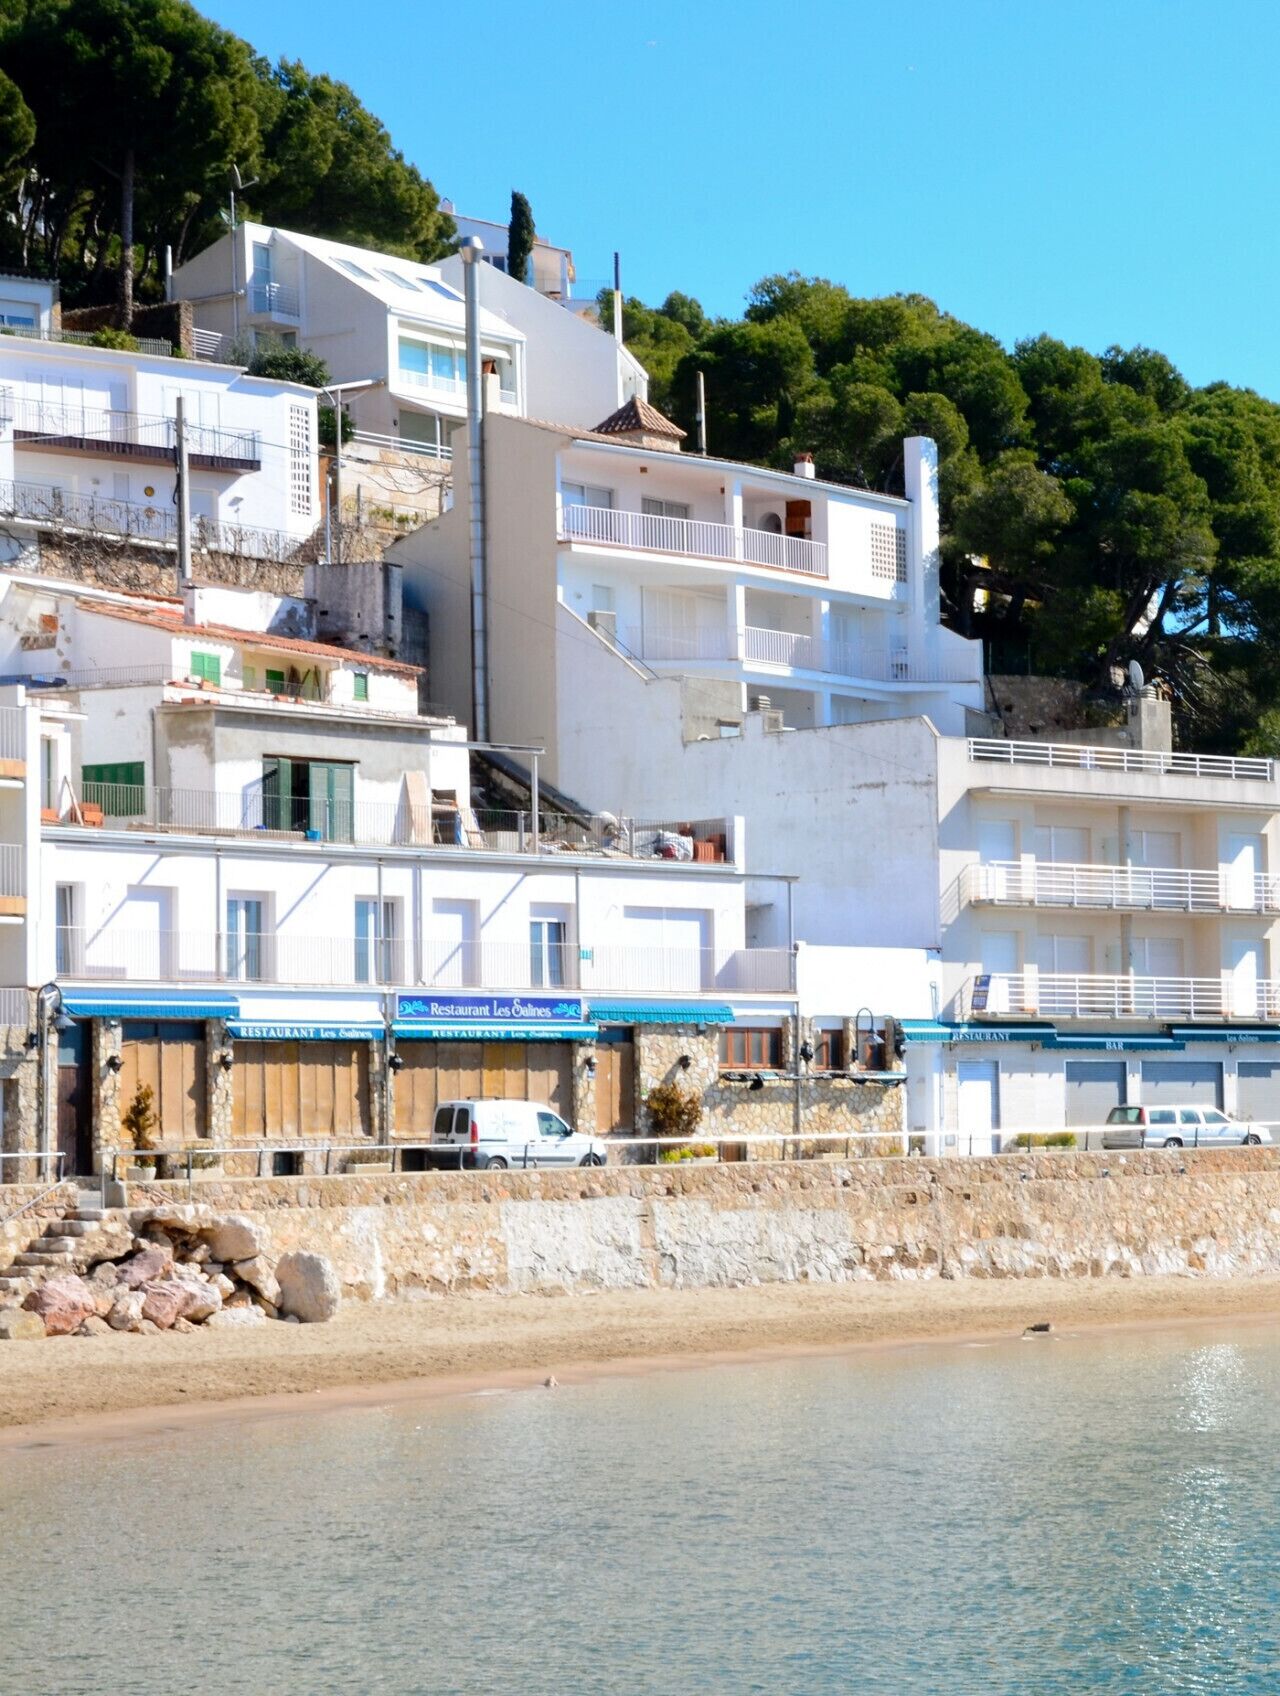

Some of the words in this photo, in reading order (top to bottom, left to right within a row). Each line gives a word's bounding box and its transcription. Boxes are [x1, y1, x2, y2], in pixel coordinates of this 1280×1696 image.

[430, 1002, 490, 1017] Restaurant
[493, 1000, 510, 1018] Les
[512, 998, 552, 1018] Salines
[240, 1026, 315, 1038] RESTAURANT
[320, 1028, 336, 1038] Les
[432, 1030, 506, 1038] RESTAURANT
[952, 1032, 1010, 1041] RESTAURANT
[1105, 1041, 1124, 1050] BAR
